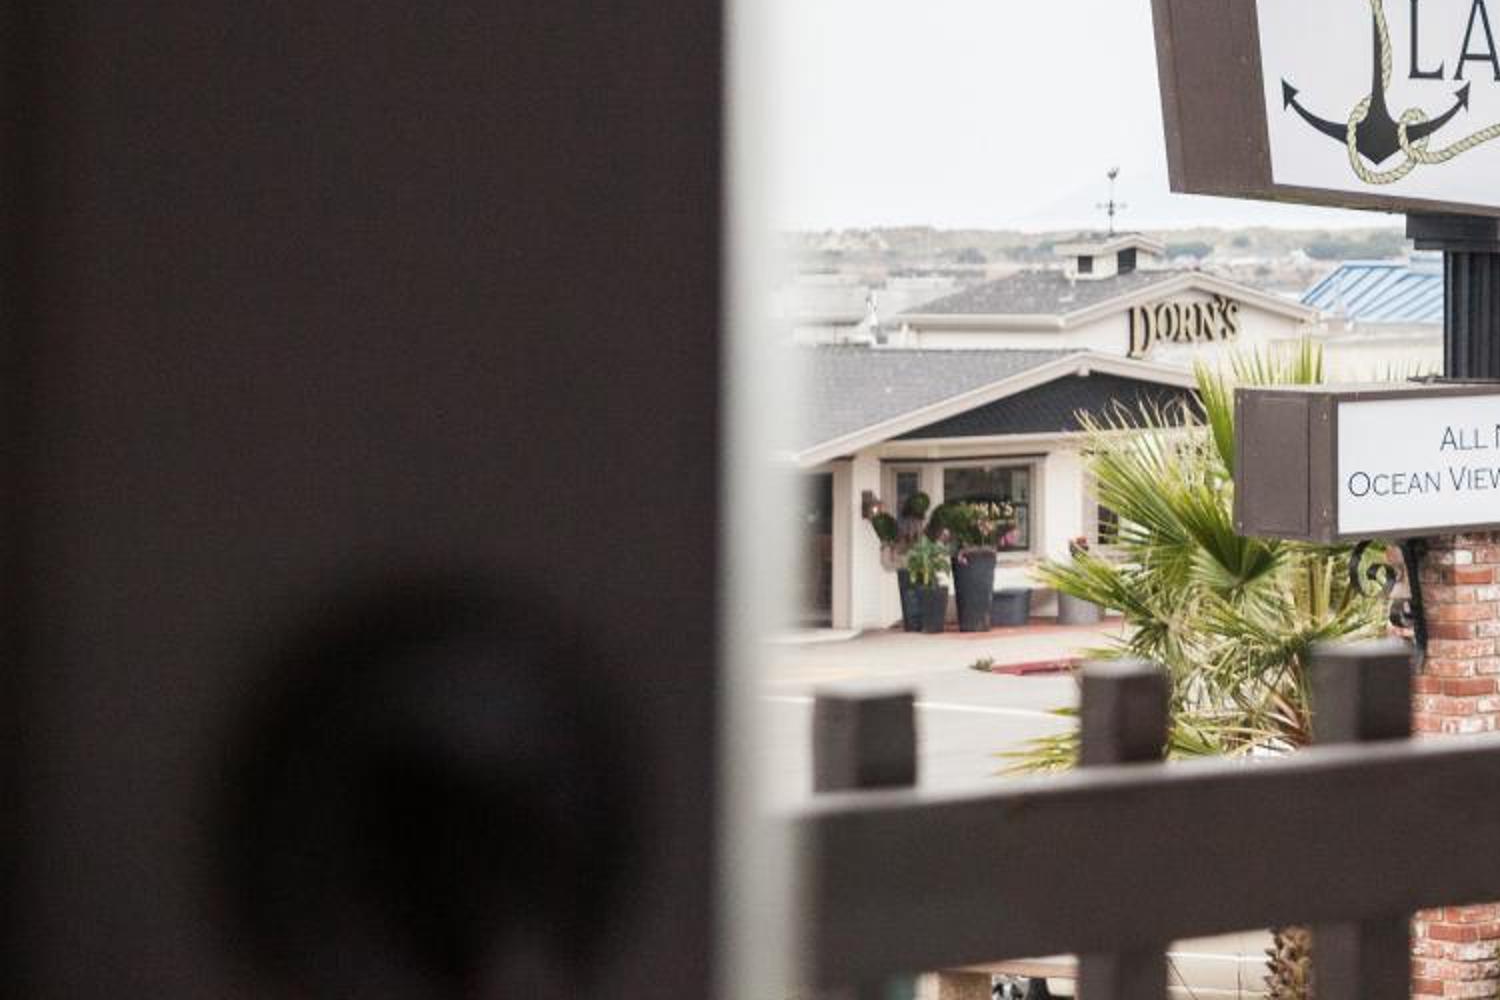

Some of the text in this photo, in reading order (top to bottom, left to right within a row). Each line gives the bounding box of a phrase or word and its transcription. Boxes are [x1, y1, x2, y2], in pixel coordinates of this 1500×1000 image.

[1126, 295, 1239, 359] DORN'S
[1440, 426, 1488, 451] ALL
[1348, 471, 1441, 497] OCEAN
